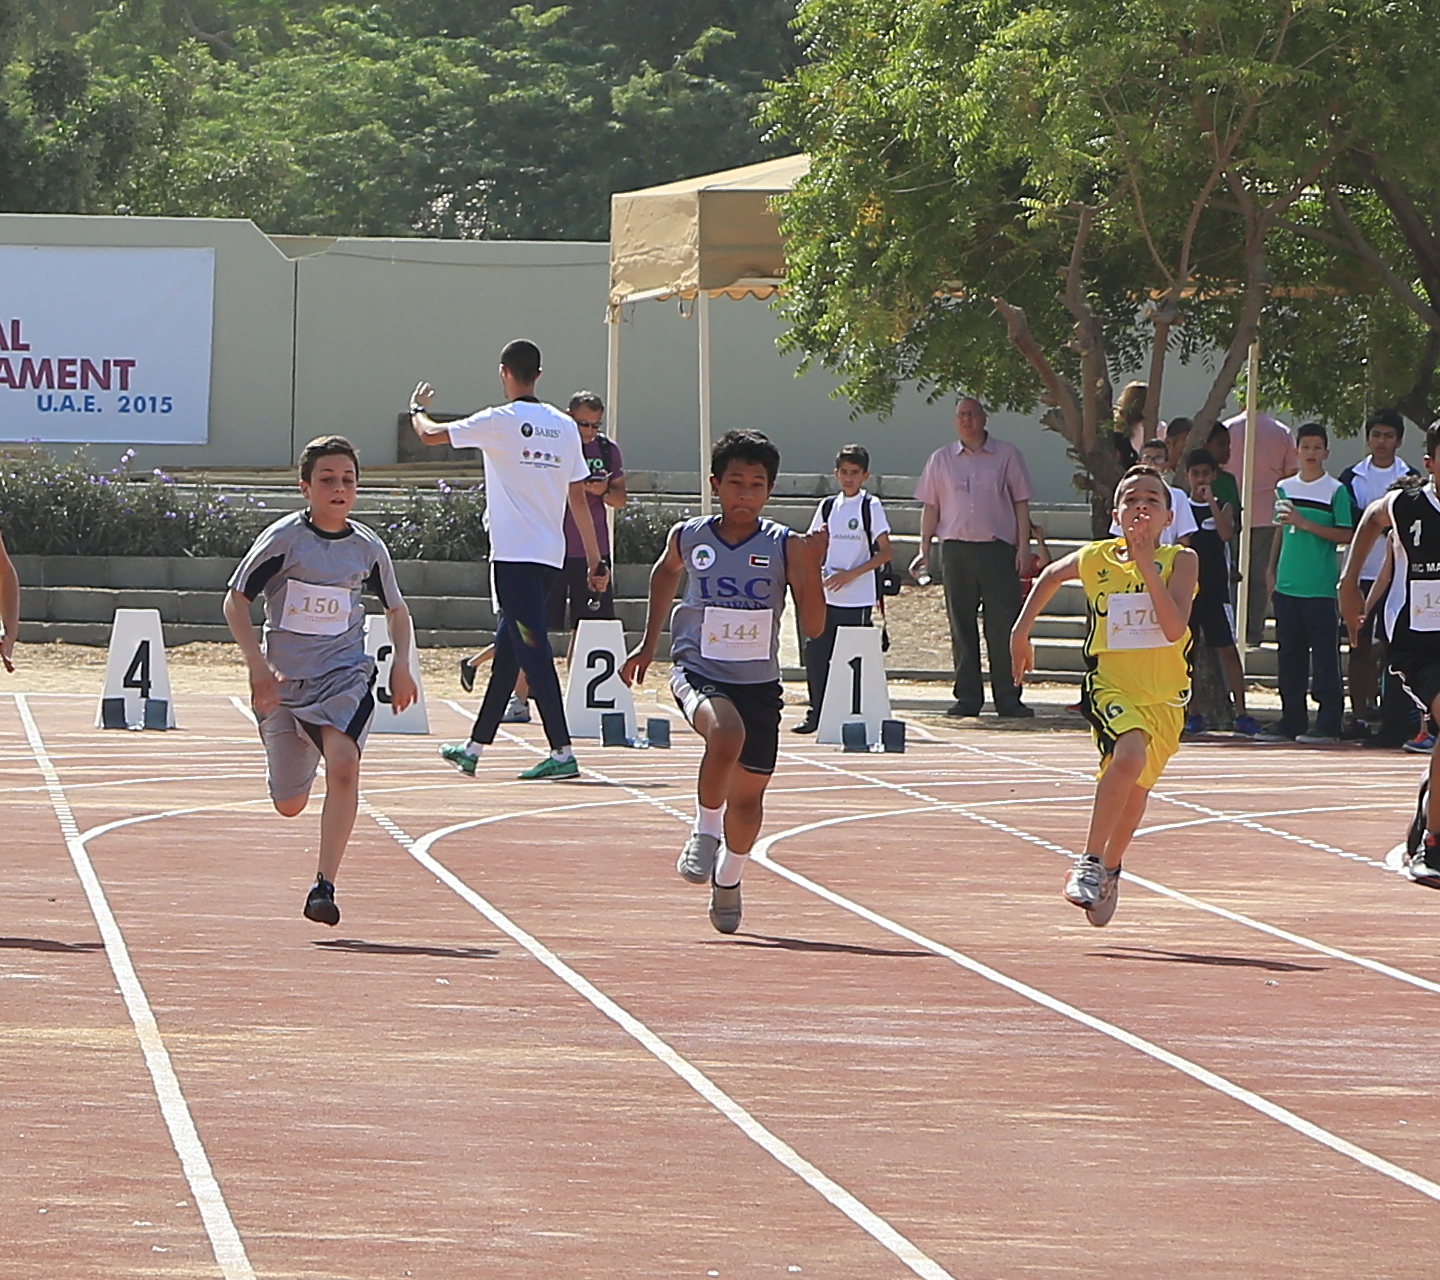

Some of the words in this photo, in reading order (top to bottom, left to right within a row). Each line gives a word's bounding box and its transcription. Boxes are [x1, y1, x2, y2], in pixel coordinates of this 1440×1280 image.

[36, 394, 103, 413] U.A.E.
[117, 395, 173, 414] 2015
[1410, 520, 1422, 547] 1
[697, 577, 772, 600] ISC
[301, 596, 340, 615] 150
[1122, 609, 1159, 627] 170
[722, 622, 760, 640] 144
[123, 640, 151, 699] 4
[586, 650, 616, 709] 2
[847, 656, 863, 715] 1
